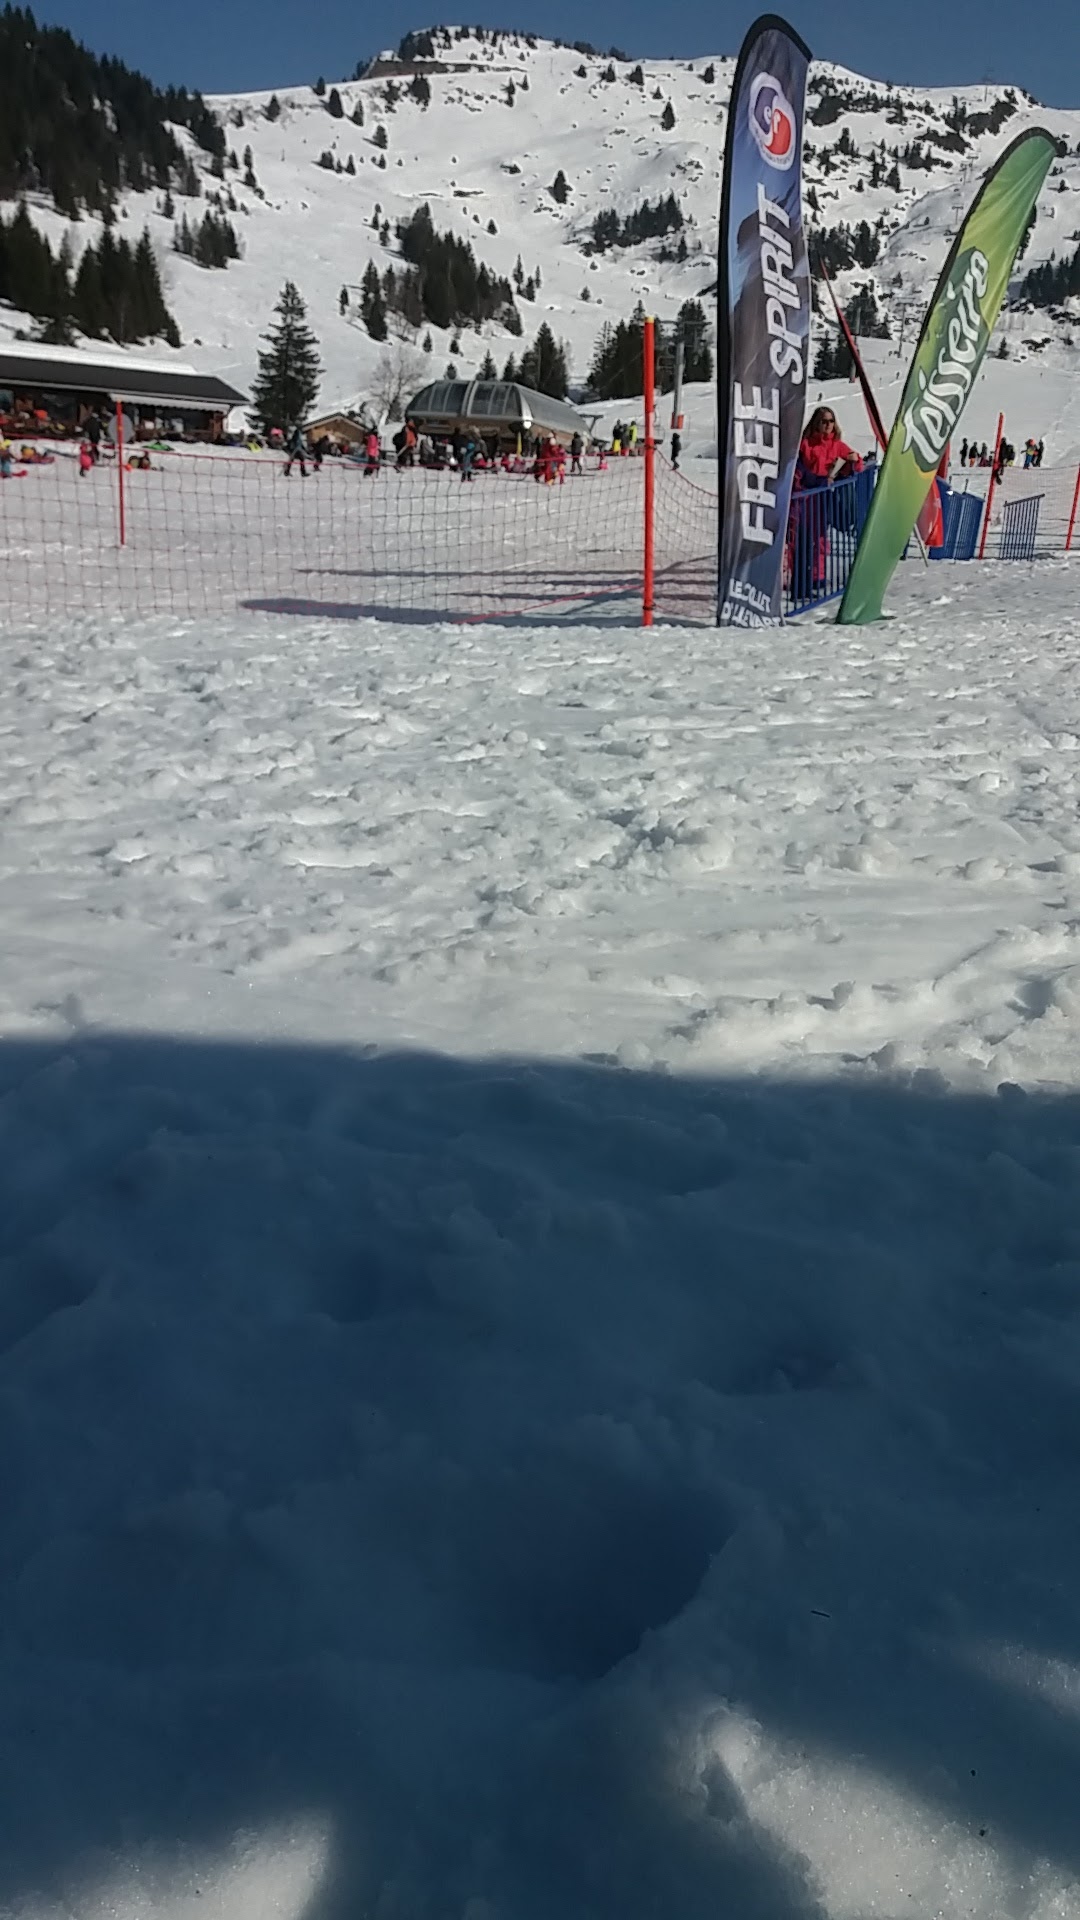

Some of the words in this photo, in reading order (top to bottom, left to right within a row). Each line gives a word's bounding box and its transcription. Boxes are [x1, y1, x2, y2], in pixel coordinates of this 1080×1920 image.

[734, 381, 780, 546] FREE
[757, 182, 803, 385] SPIRIT
[729, 578, 742, 600] LE
